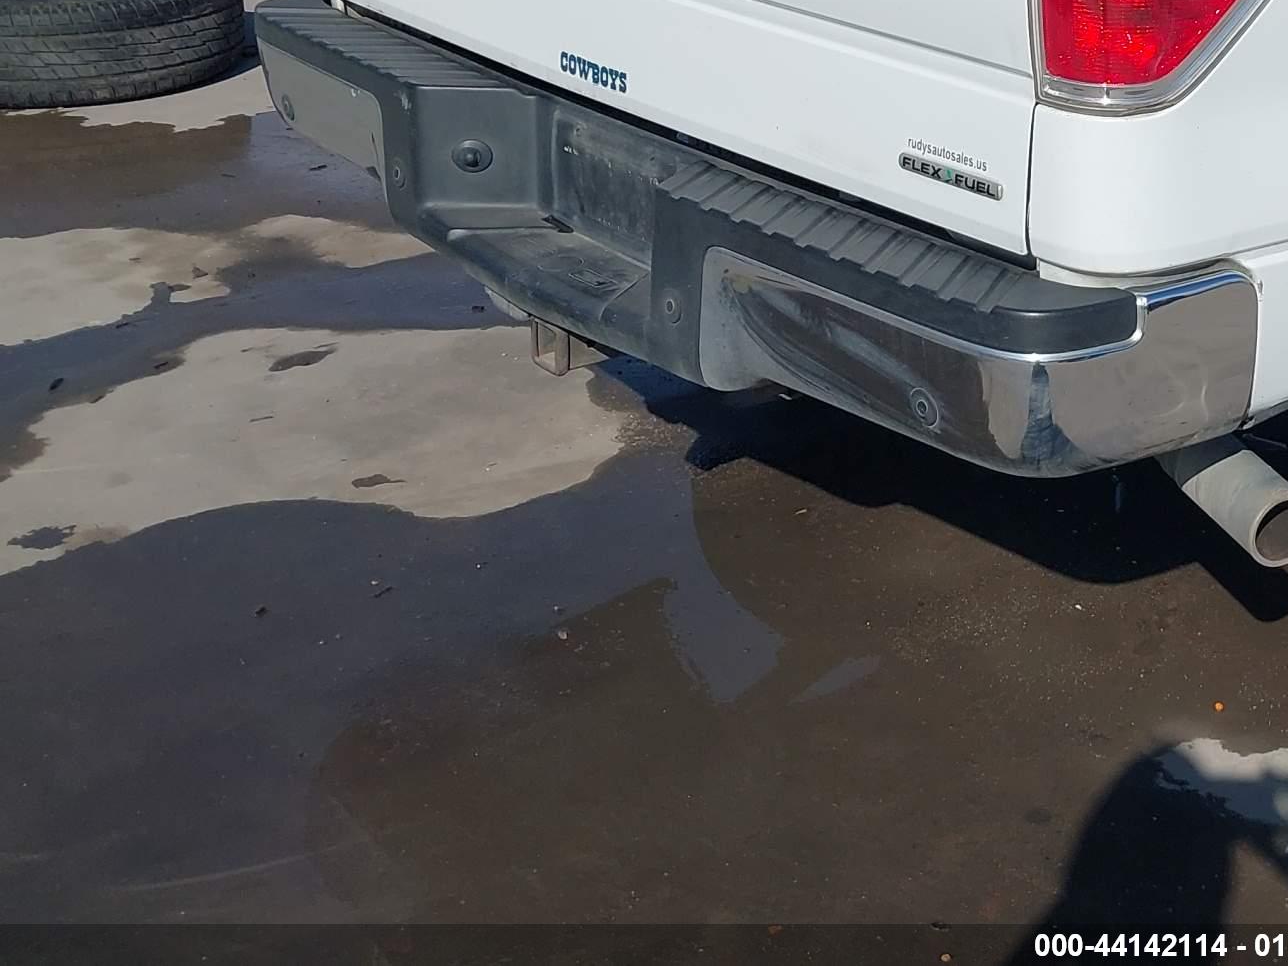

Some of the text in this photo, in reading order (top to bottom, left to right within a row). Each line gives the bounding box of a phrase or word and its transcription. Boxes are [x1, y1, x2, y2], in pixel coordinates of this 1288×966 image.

[560, 51, 627, 93] COWBOYS
[908, 138, 987, 172] rudysautosales.us
[903, 156, 995, 197] FLEX FUEL
